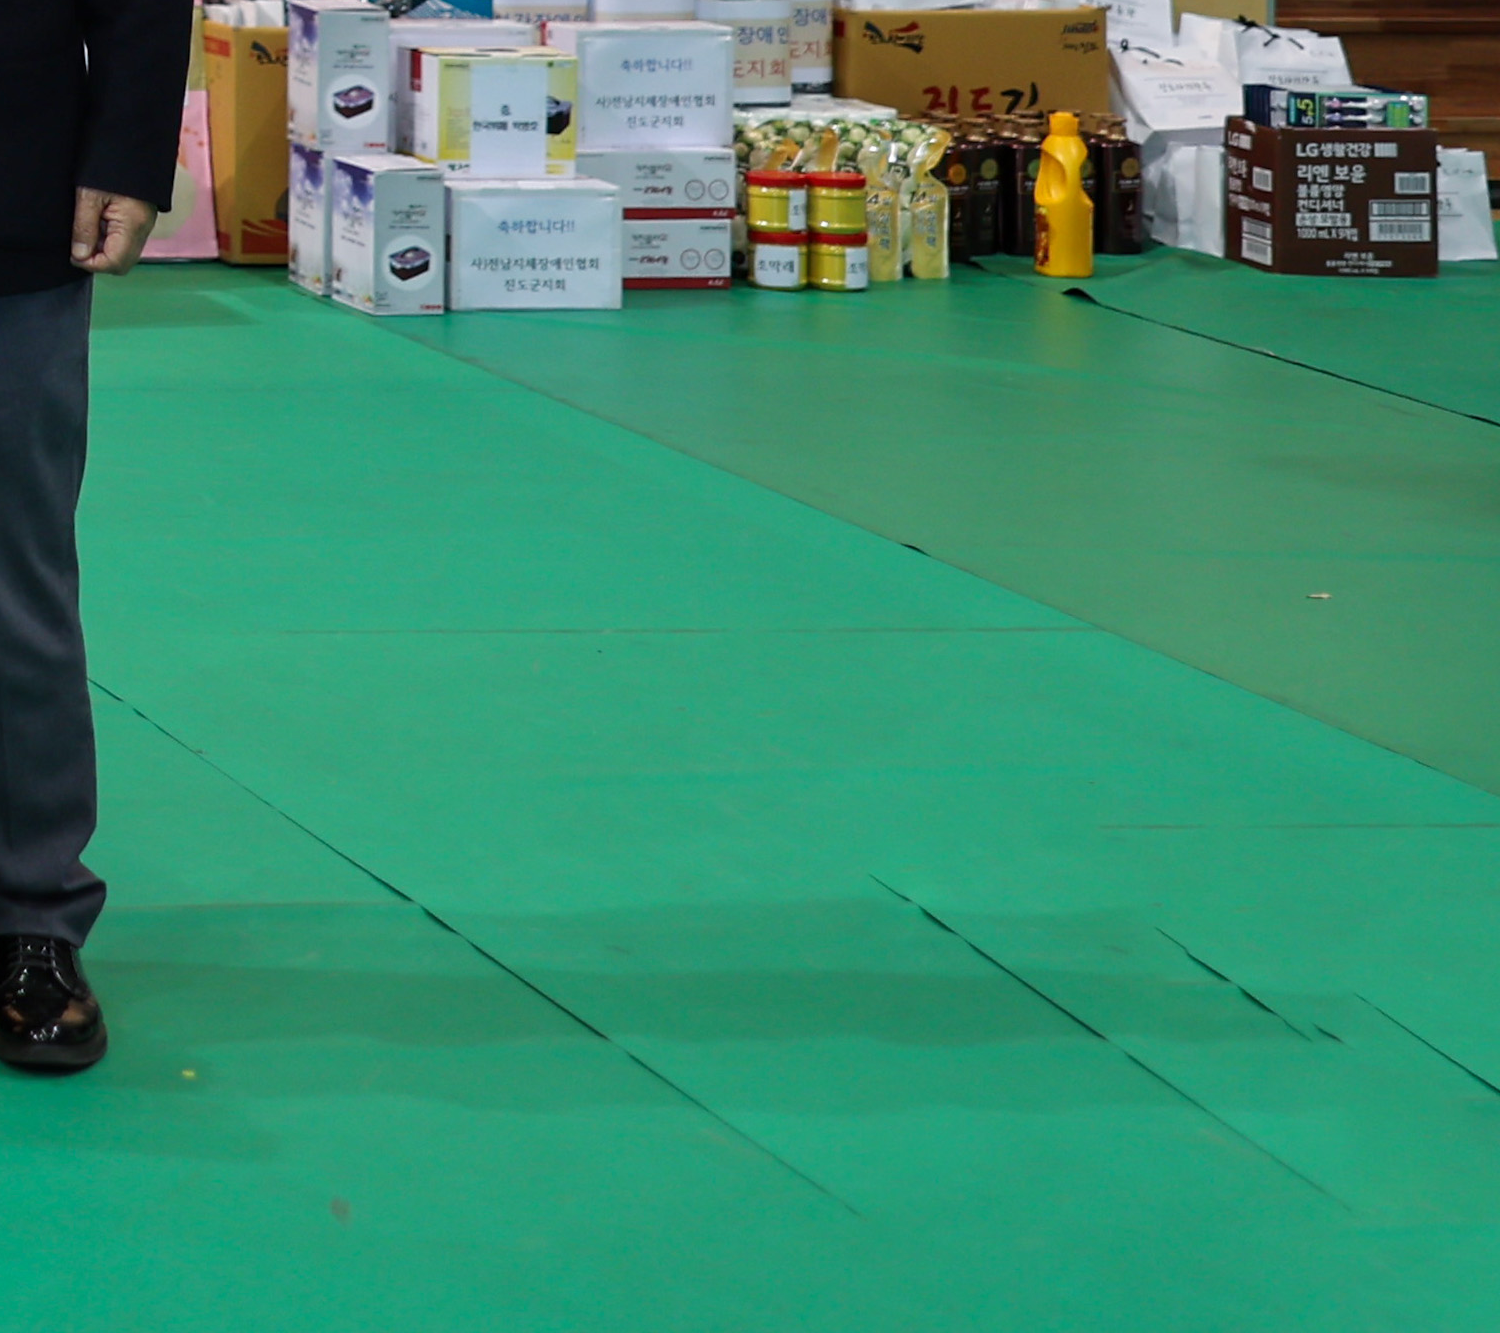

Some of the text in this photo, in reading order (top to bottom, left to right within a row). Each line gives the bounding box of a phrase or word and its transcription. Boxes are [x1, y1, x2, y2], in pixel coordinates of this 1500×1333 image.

[737, 26, 790, 46] 장애인
[732, 58, 787, 79] 도지회
[626, 116, 685, 129] 진도군지회
[1296, 142, 1373, 158] LG생활건강
[1297, 164, 1367, 184] 리엔 보윤
[1297, 199, 1344, 212] 컨디셔너
[504, 279, 567, 293] 진도군지회
